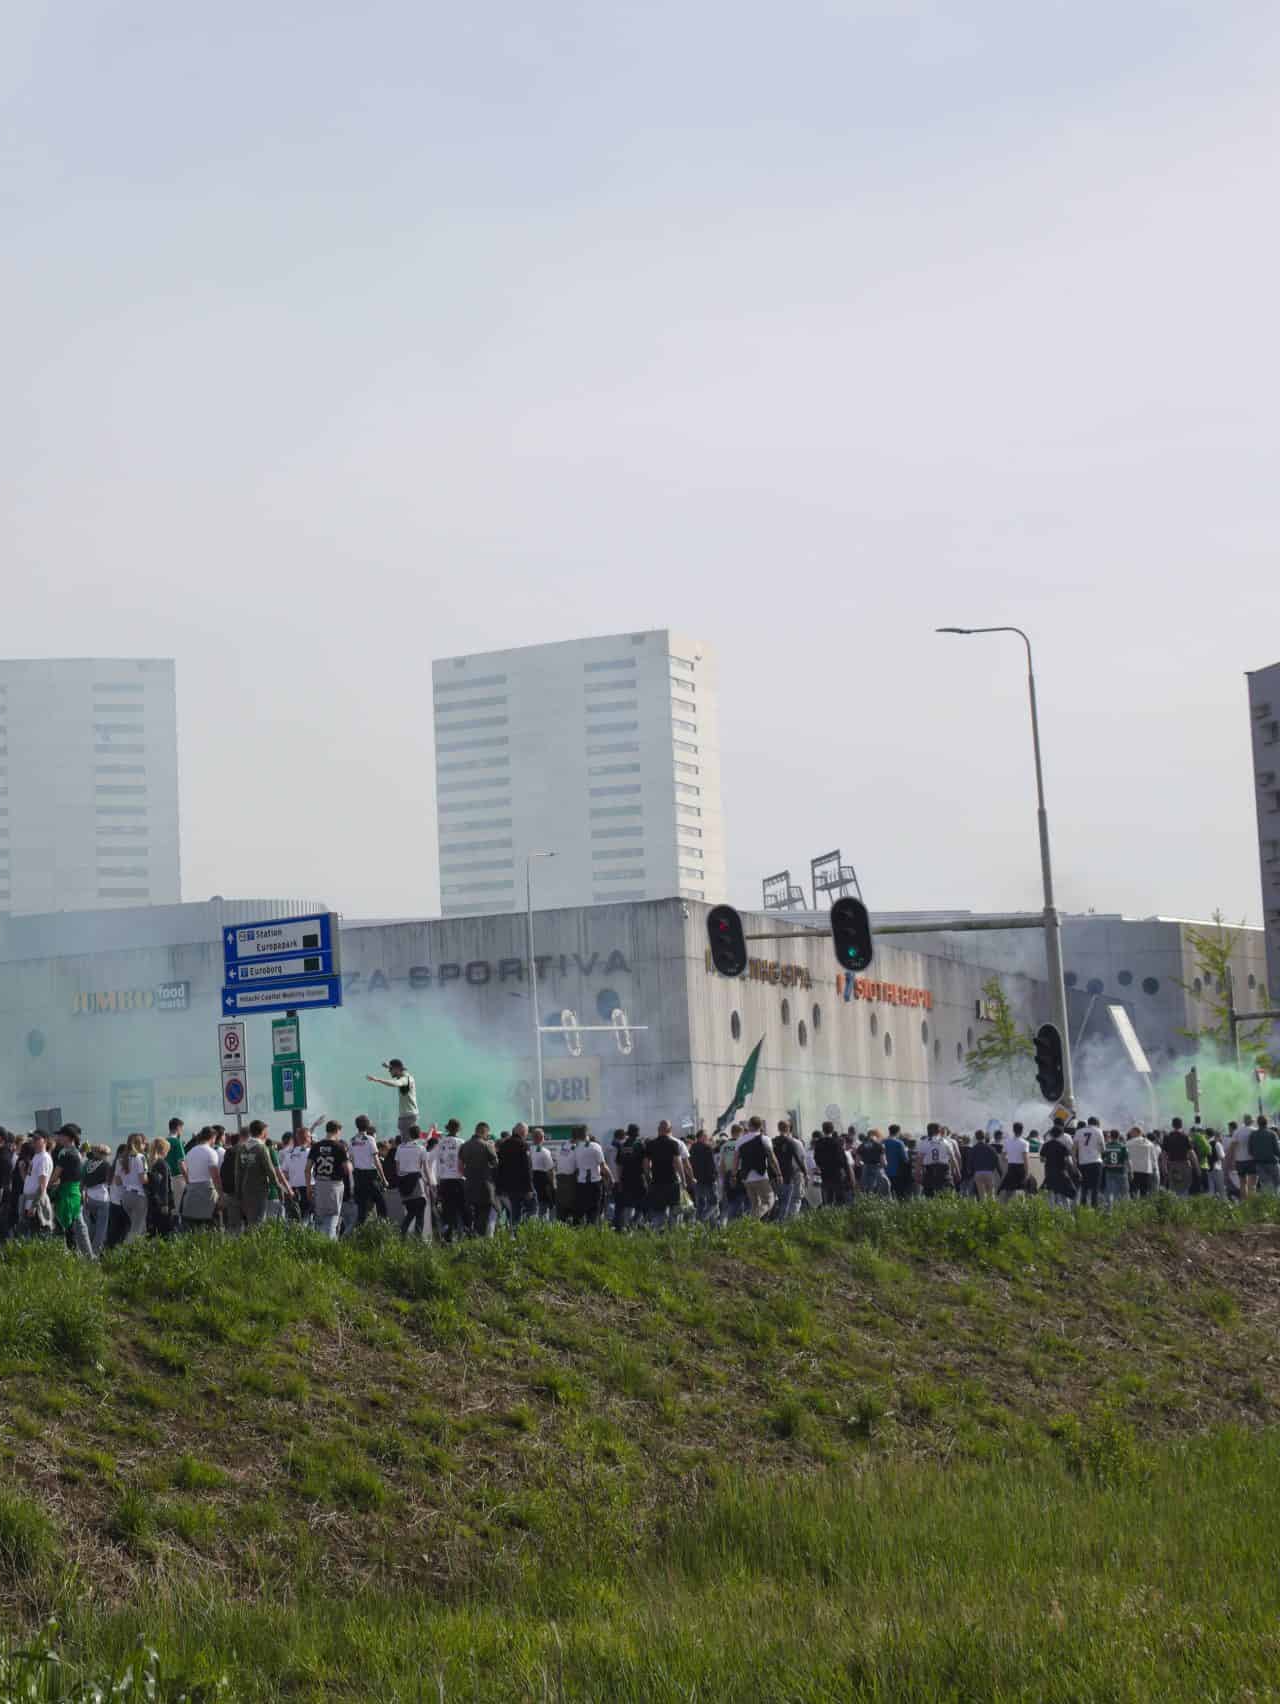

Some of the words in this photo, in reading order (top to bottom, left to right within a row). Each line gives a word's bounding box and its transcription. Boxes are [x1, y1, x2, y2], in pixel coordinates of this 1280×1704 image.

[256, 928, 282, 938] Station
[256, 940, 298, 952] Europapark
[250, 966, 282, 976] Euroborg
[409, 949, 632, 989] SPORTIVA
[159, 983, 185, 998] food
[1083, 1132, 1092, 1147] 7
[316, 1155, 335, 1175] 25
